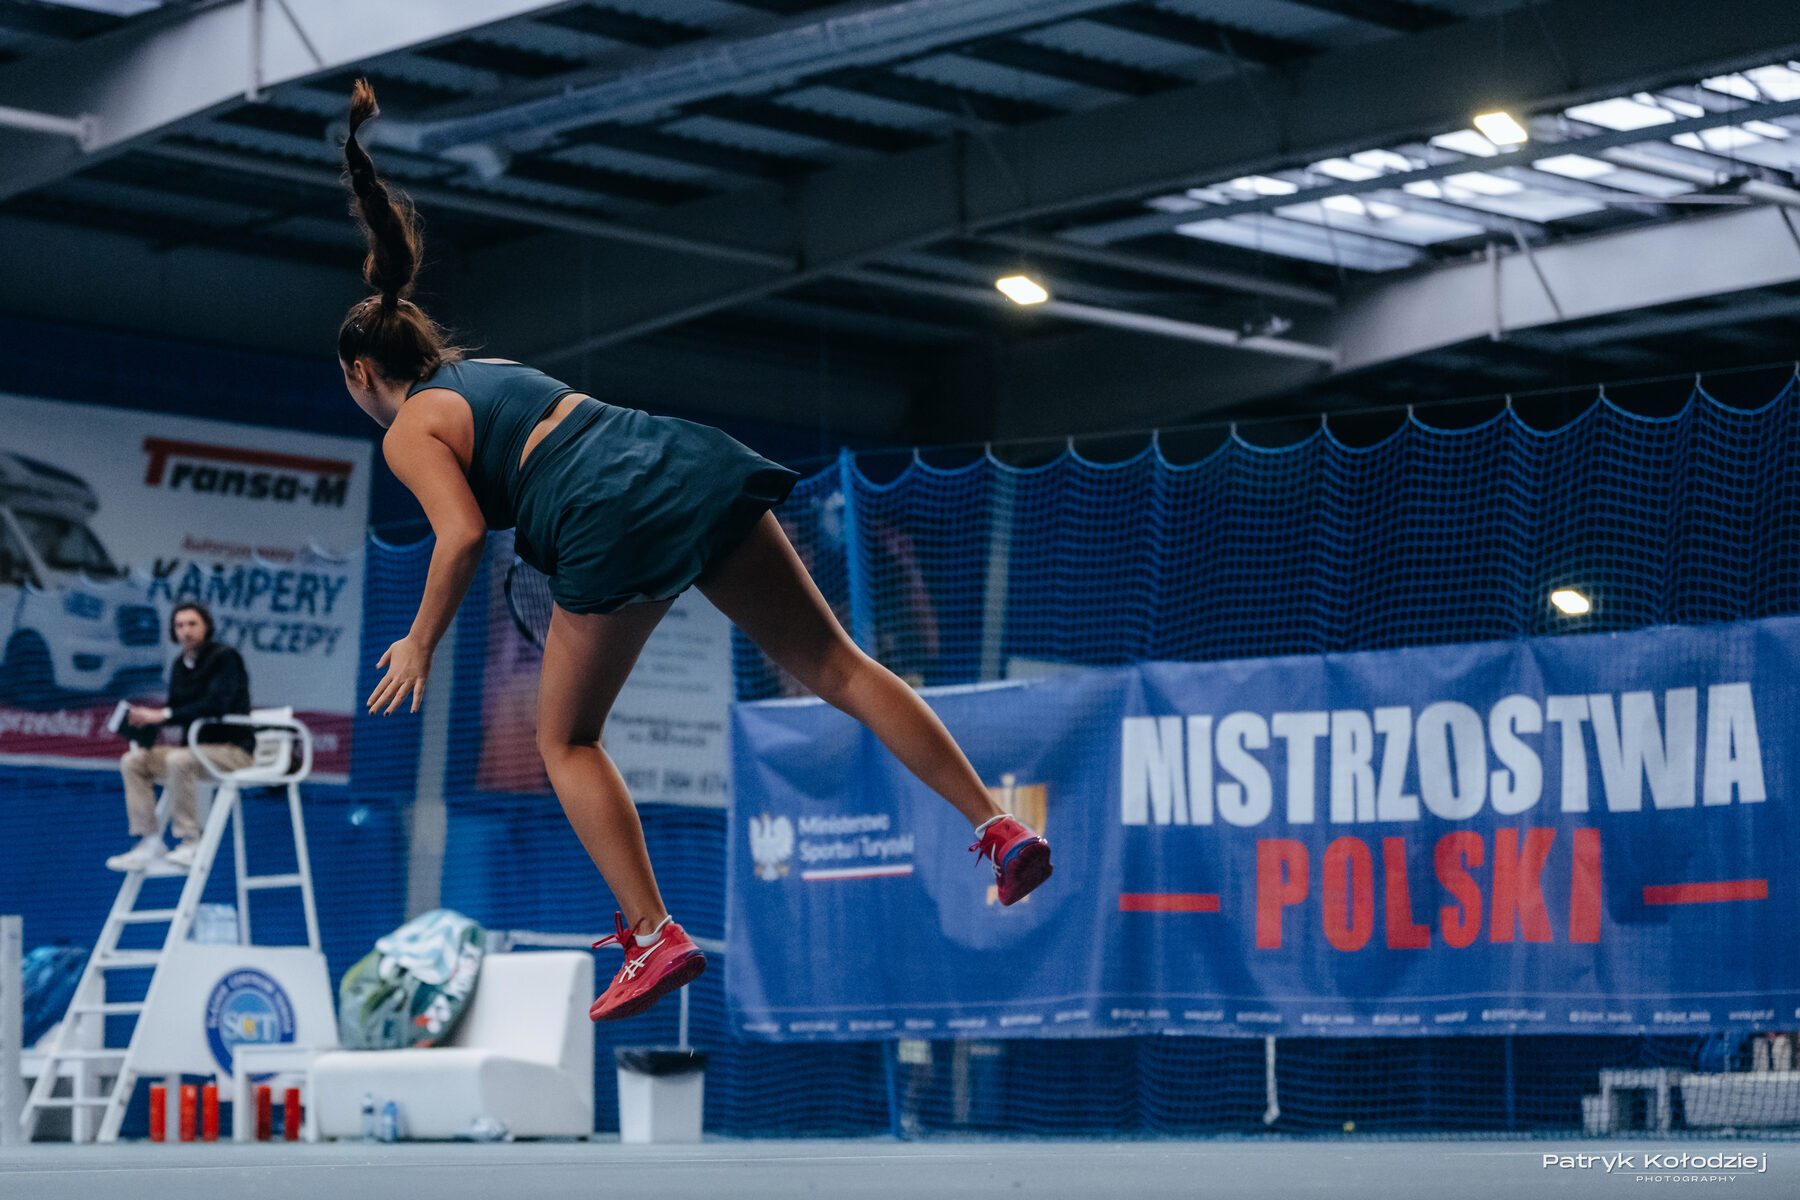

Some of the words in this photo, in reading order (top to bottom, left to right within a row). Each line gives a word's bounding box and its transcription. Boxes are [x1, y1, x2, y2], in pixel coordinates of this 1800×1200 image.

[143, 437, 354, 507] Transa-M
[147, 557, 349, 616] KAMPERY
[215, 616, 343, 657] ZYCZEPY
[1121, 682, 1767, 826] MISTRZOSTWA
[1256, 828, 1601, 951] POLSKI
